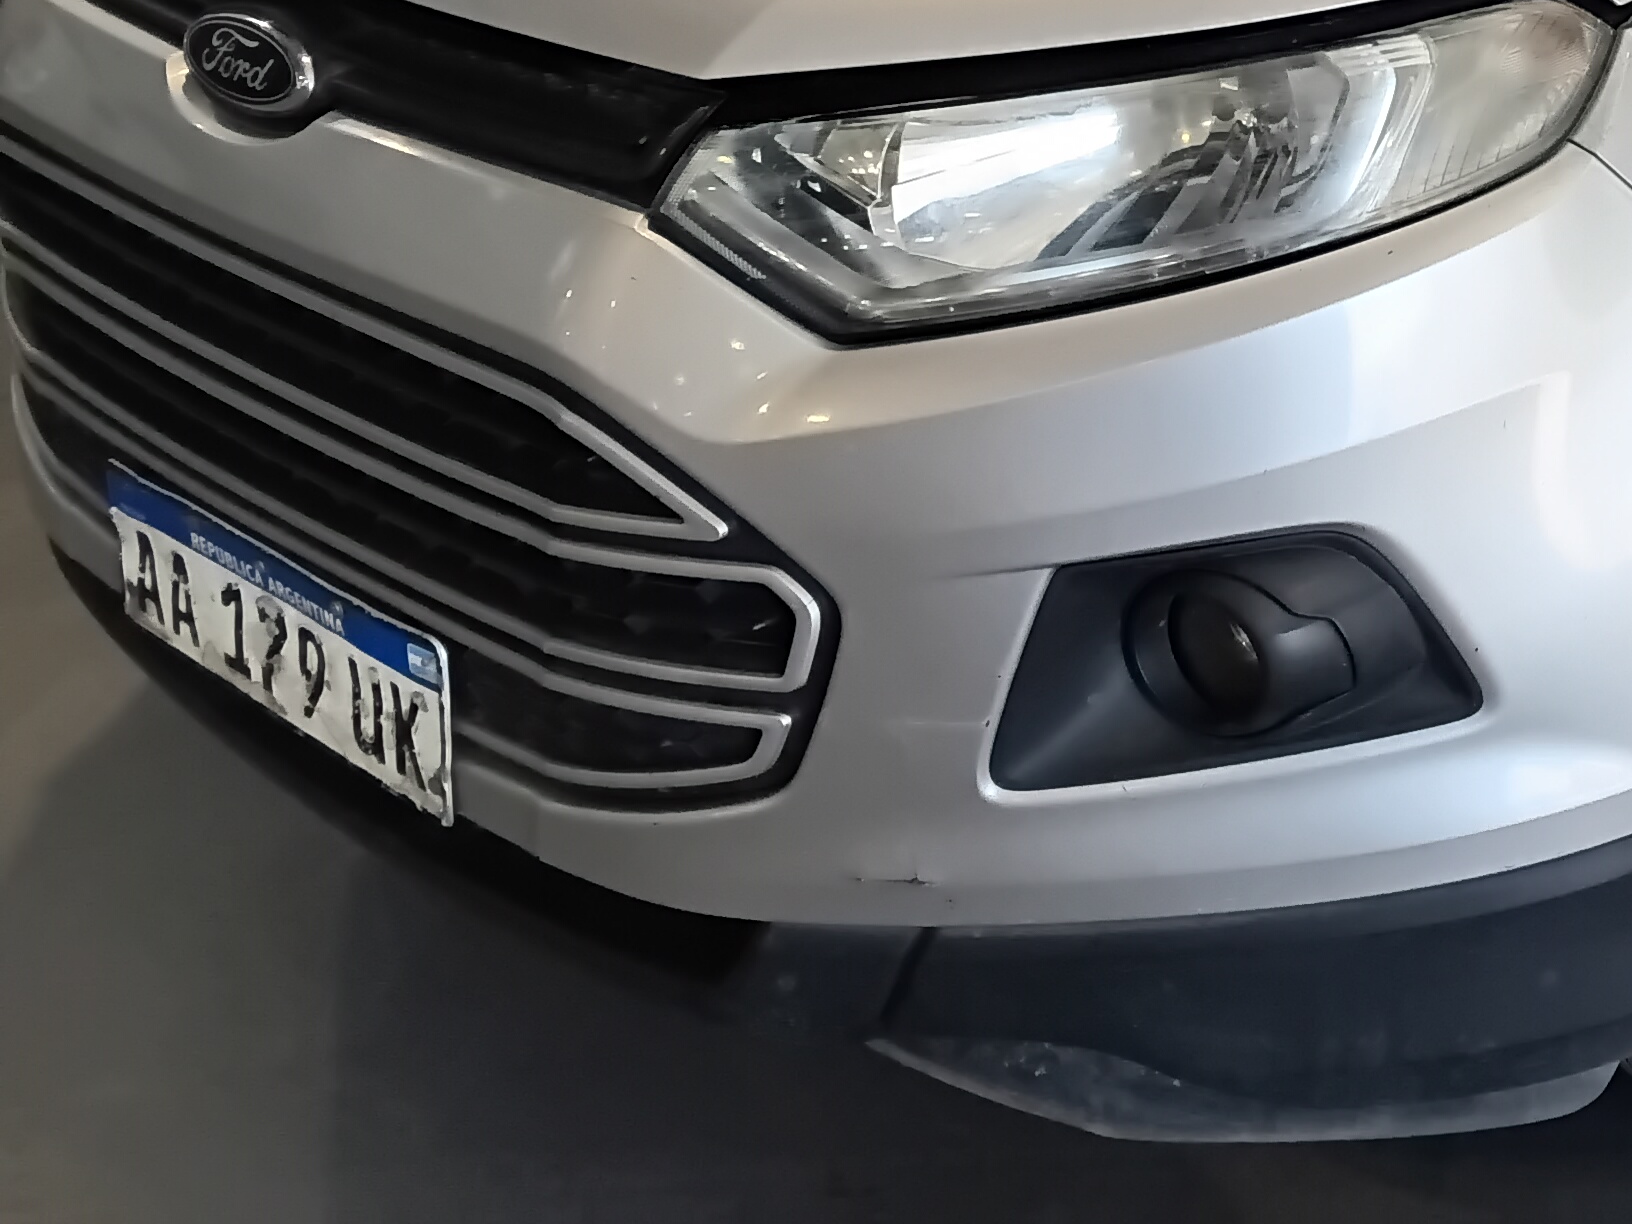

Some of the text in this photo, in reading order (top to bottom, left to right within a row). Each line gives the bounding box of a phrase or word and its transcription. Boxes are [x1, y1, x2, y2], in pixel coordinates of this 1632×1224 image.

[202, 27, 275, 91] Ford
[190, 532, 345, 636] REPUBLICA ARGENTINA
[136, 530, 200, 648] AA
[348, 652, 428, 791] UK
